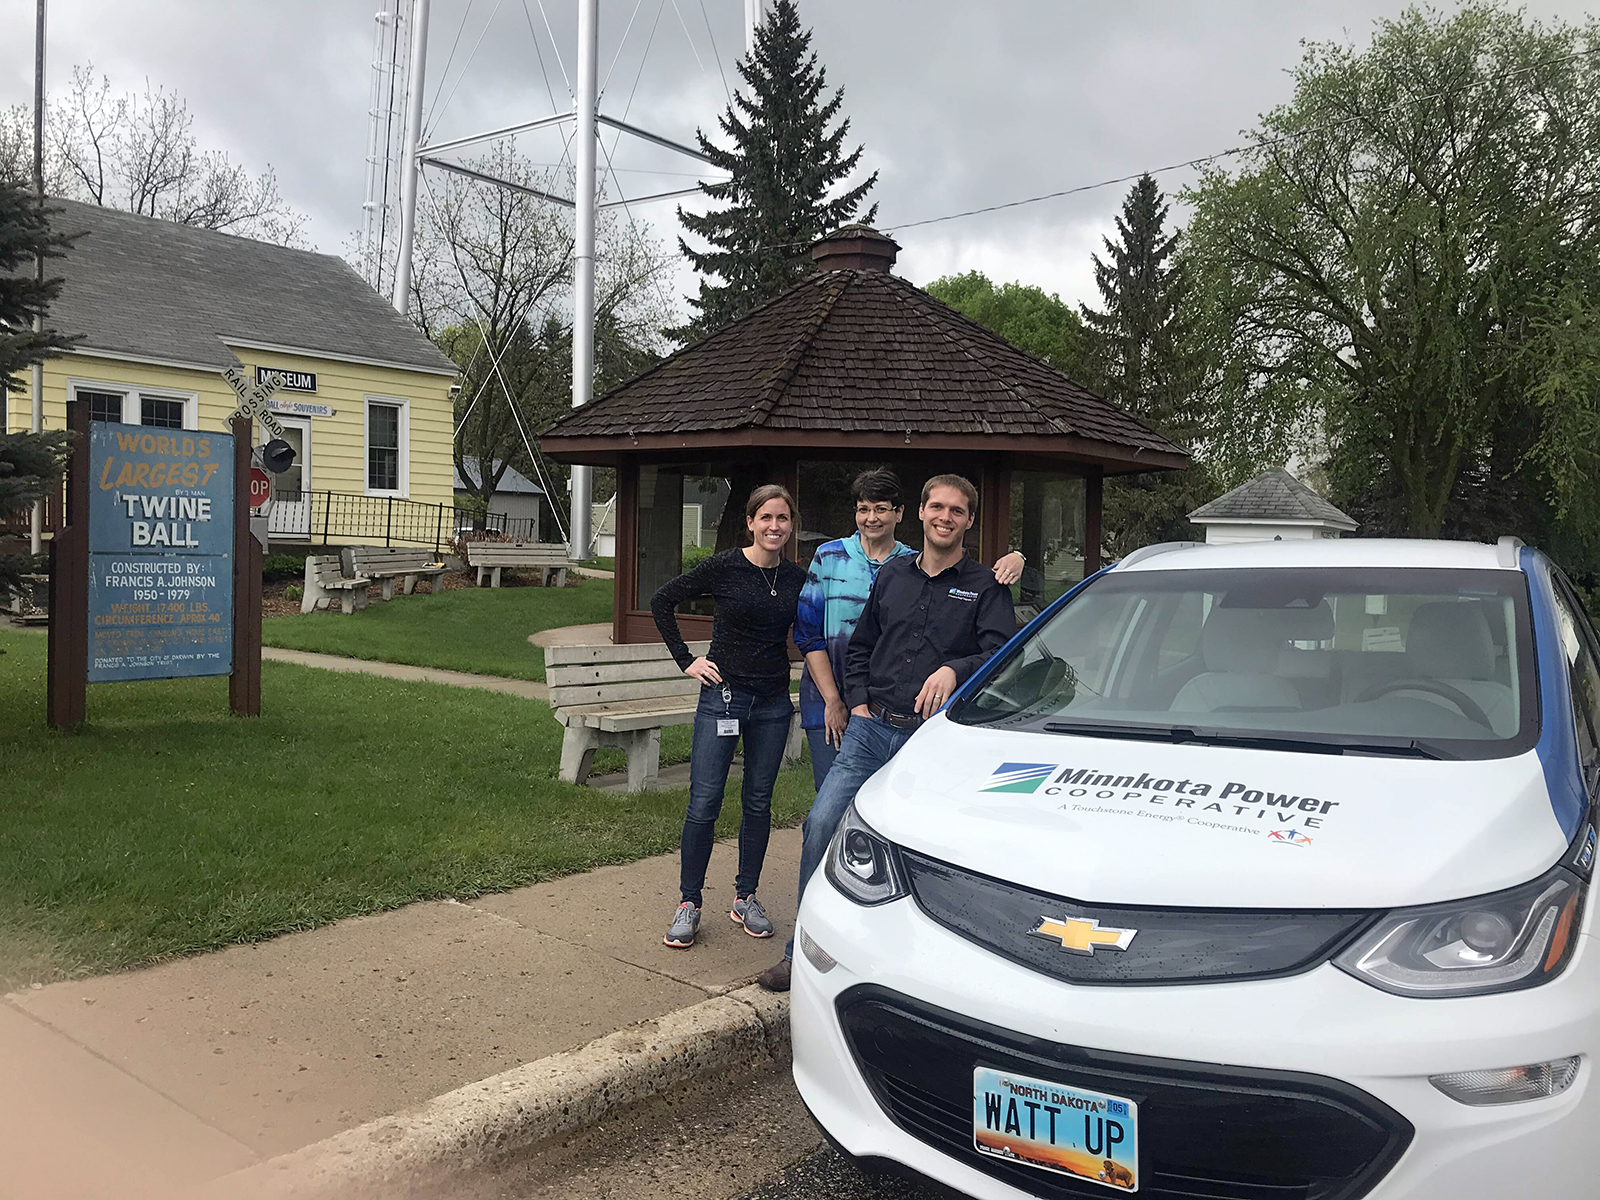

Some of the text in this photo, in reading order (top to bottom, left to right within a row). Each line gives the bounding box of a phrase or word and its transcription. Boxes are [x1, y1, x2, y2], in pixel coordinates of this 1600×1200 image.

[224, 368, 248, 398] RAIL
[260, 369, 312, 388] MSEUM
[259, 409, 282, 436] ROAD
[293, 403, 328, 415] SOUVENIRS
[99, 457, 220, 491] LARGEST
[122, 495, 211, 521] TWINE
[132, 521, 199, 546] BALL
[105, 575, 154, 588] FRANCIS
[111, 562, 182, 574] CONSTRUCTED
[1053, 768, 1340, 815] Minnkota Power
[1044, 785, 1325, 830] COOPERATIVE
[1057, 803, 1068, 811] A
[1070, 803, 1135, 817] Touchstone
[1186, 816, 1262, 836] Cooperative
[1009, 1083, 1048, 1102] NORTH
[1051, 1093, 1099, 1113] DAKOTA
[1112, 1102, 1123, 1113] 05
[985, 1091, 1125, 1160] WATT UP
